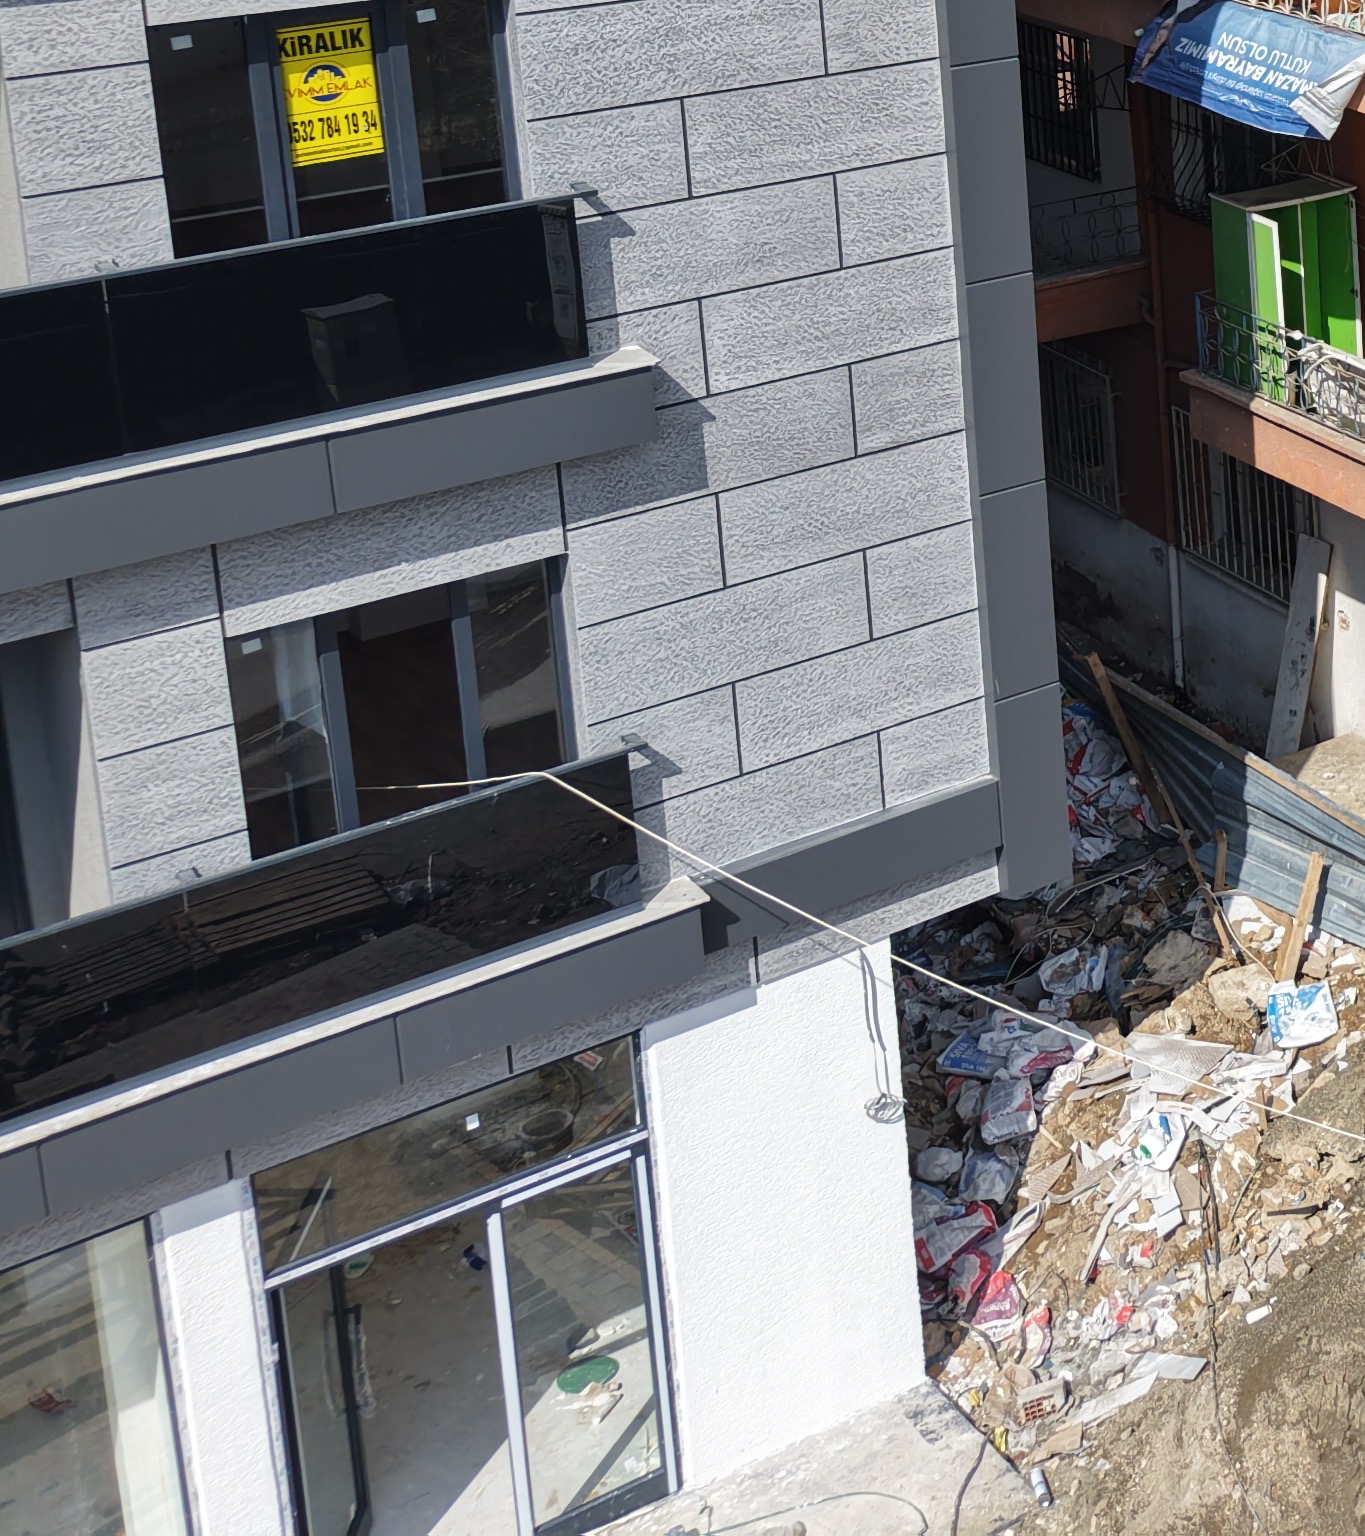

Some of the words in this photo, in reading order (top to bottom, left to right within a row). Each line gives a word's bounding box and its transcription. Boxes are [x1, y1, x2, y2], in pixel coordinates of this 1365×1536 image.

[1174, 36, 1267, 81] BAYRAMIMIZ
[1217, 31, 1269, 61] OLSUN
[1267, 49, 1313, 75] KUTLU
[327, 77, 373, 94] EMLAK
[1263, 69, 1318, 95] MAZAN
[318, 115, 342, 140] 784
[344, 112, 360, 136] 19
[362, 109, 378, 134] 34
